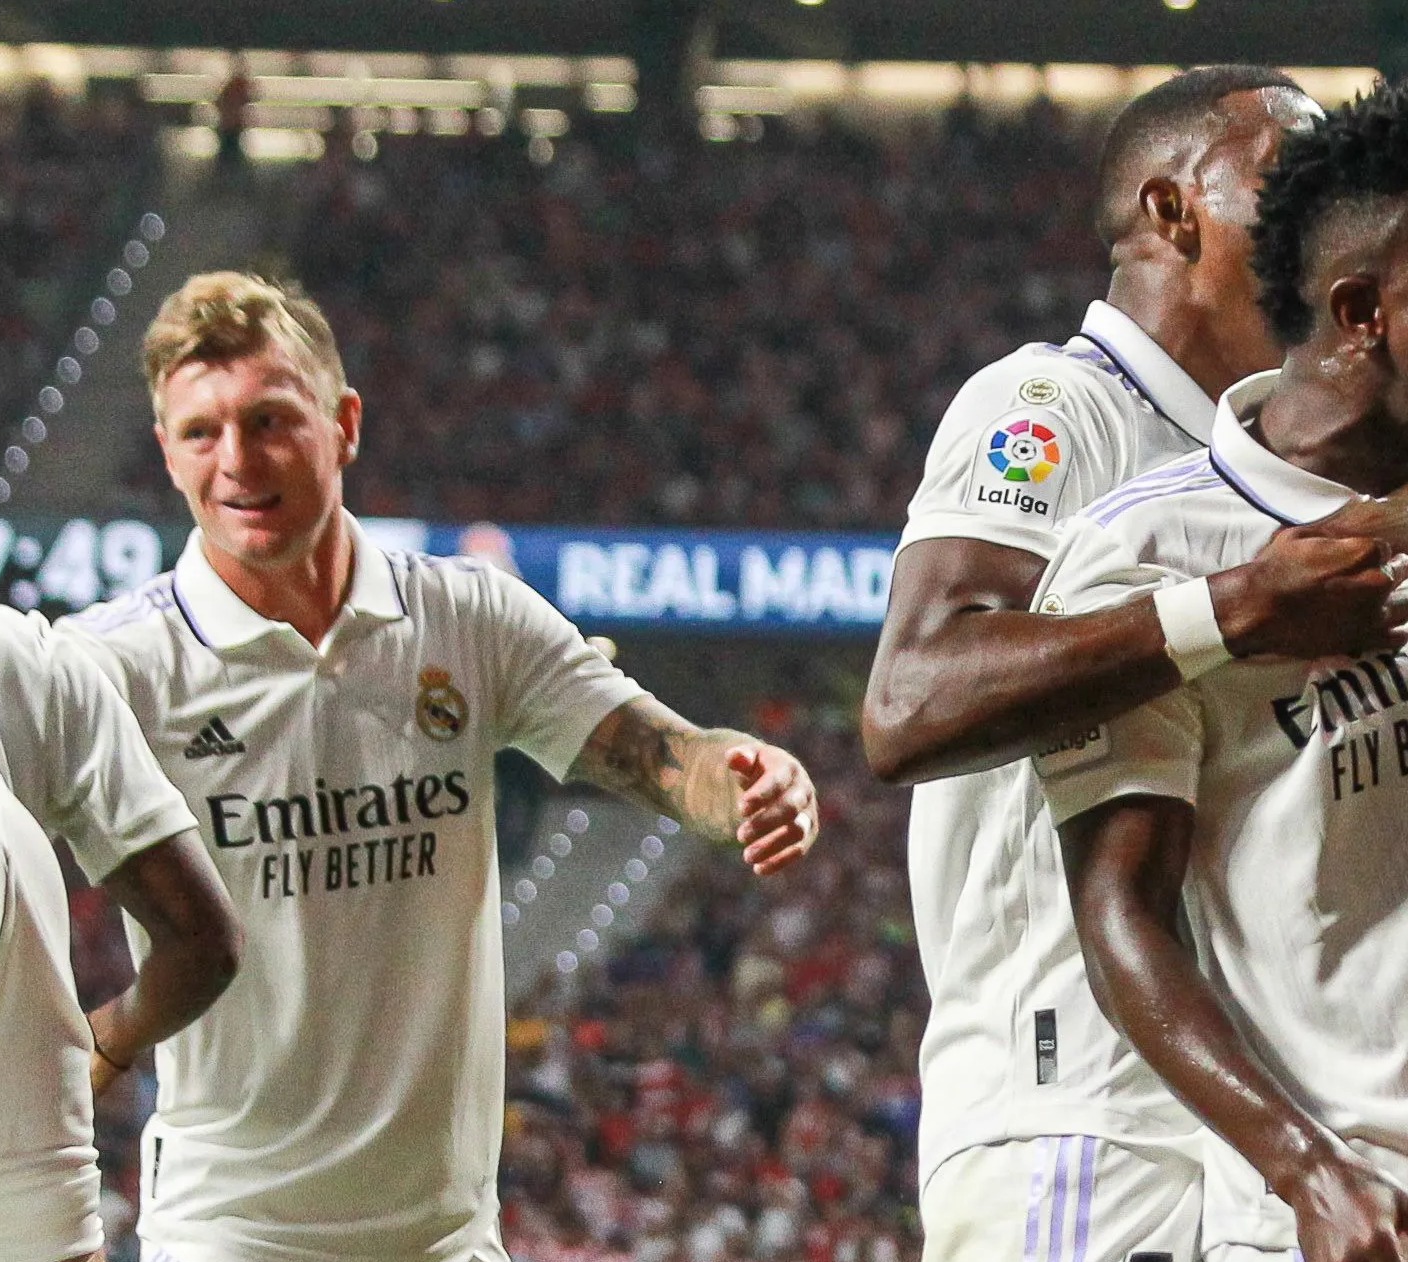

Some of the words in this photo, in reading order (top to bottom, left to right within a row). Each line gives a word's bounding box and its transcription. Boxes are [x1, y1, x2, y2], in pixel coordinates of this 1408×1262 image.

[978, 485, 1049, 515] LaLiga
[557, 541, 738, 620] REAL
[740, 545, 894, 623] MAD
[1328, 730, 1380, 800] FLY
[205, 769, 470, 850] Emirates
[262, 848, 313, 900] FLY
[325, 831, 437, 892] BETTER
